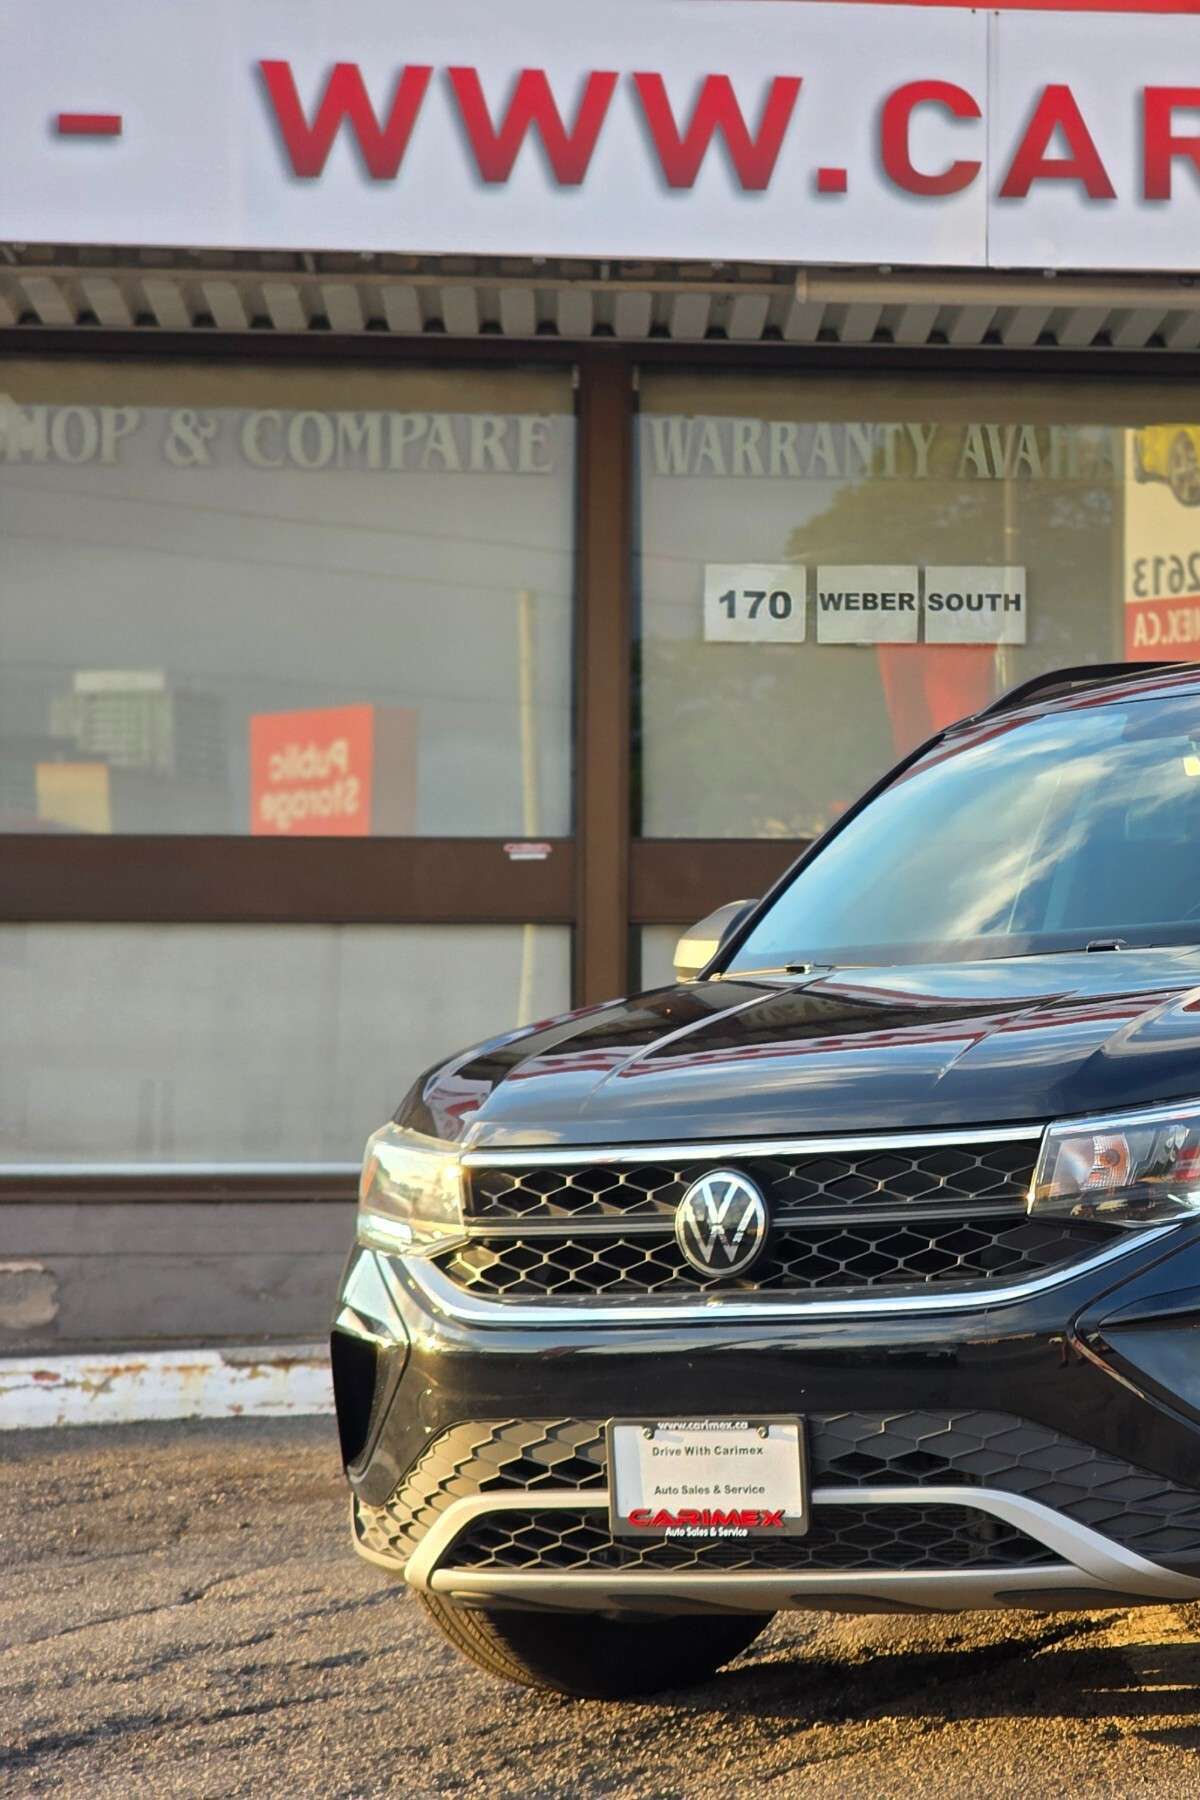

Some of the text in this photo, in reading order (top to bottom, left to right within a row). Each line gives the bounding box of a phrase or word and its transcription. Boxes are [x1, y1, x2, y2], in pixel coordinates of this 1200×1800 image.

[164, 408, 218, 467] &
[241, 409, 553, 474] COMPARE
[650, 416, 937, 479] WARRANTY
[718, 590, 1022, 620] 170 WEBER SOUTH
[652, 1445, 764, 1457] Drive With Carimex
[654, 1485, 765, 1496] Auto Sales & Service
[627, 1508, 786, 1528] CARIMEX
